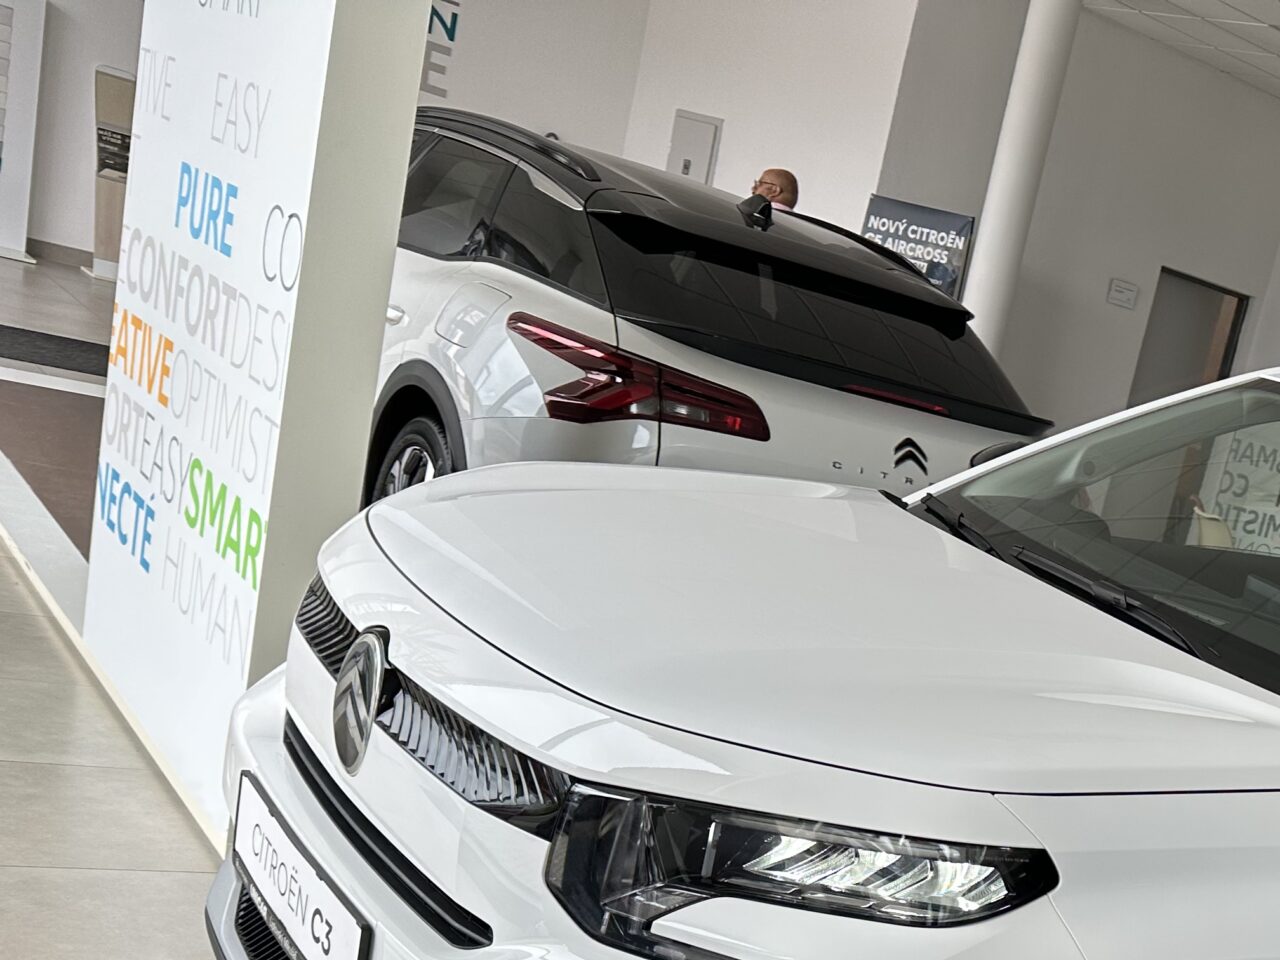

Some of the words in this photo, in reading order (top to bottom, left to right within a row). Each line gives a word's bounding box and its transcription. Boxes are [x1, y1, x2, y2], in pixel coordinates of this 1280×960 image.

[211, 72, 271, 158] EASY
[174, 161, 238, 258] PURE
[868, 215, 908, 236] NOVÝ
[907, 225, 966, 250] CITROËN
[884, 237, 949, 264] AIRCROSS
[127, 228, 237, 358] CONFORT
[171, 350, 279, 495] OPTIMIST
[832, 461, 934, 486] CITR
[140, 411, 193, 514] EASY
[184, 458, 267, 591] SMAR
[162, 526, 252, 681] HUMAN
[252, 823, 309, 926] CITROËN
[310, 907, 334, 956] C3
